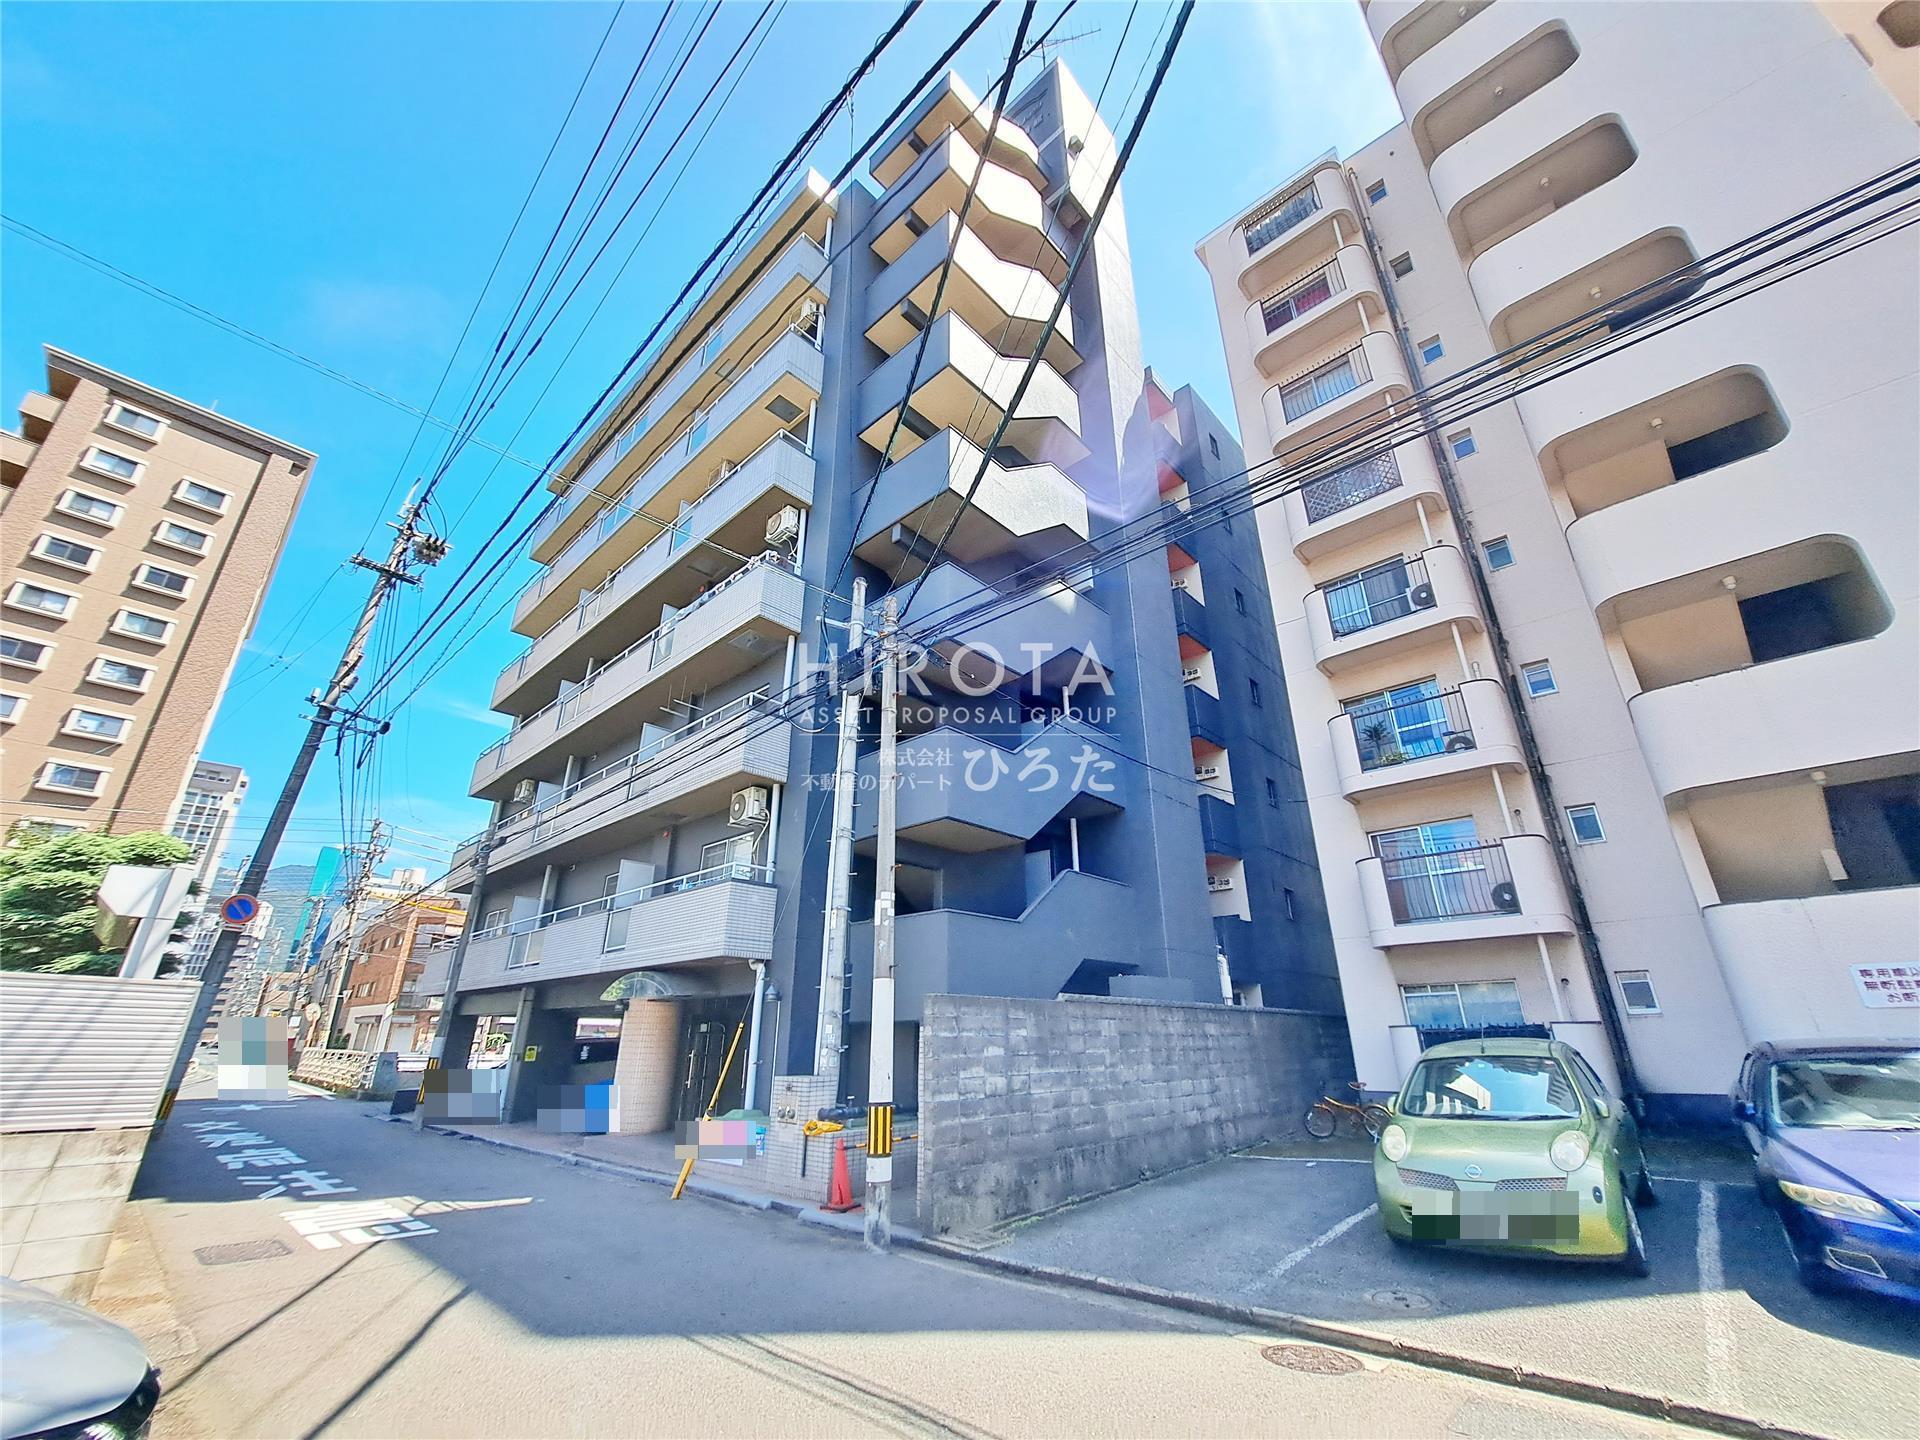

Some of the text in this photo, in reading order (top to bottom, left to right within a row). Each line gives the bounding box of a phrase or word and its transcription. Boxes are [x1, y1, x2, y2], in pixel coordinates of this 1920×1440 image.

[182, 1120, 440, 1251] 交差点注意
